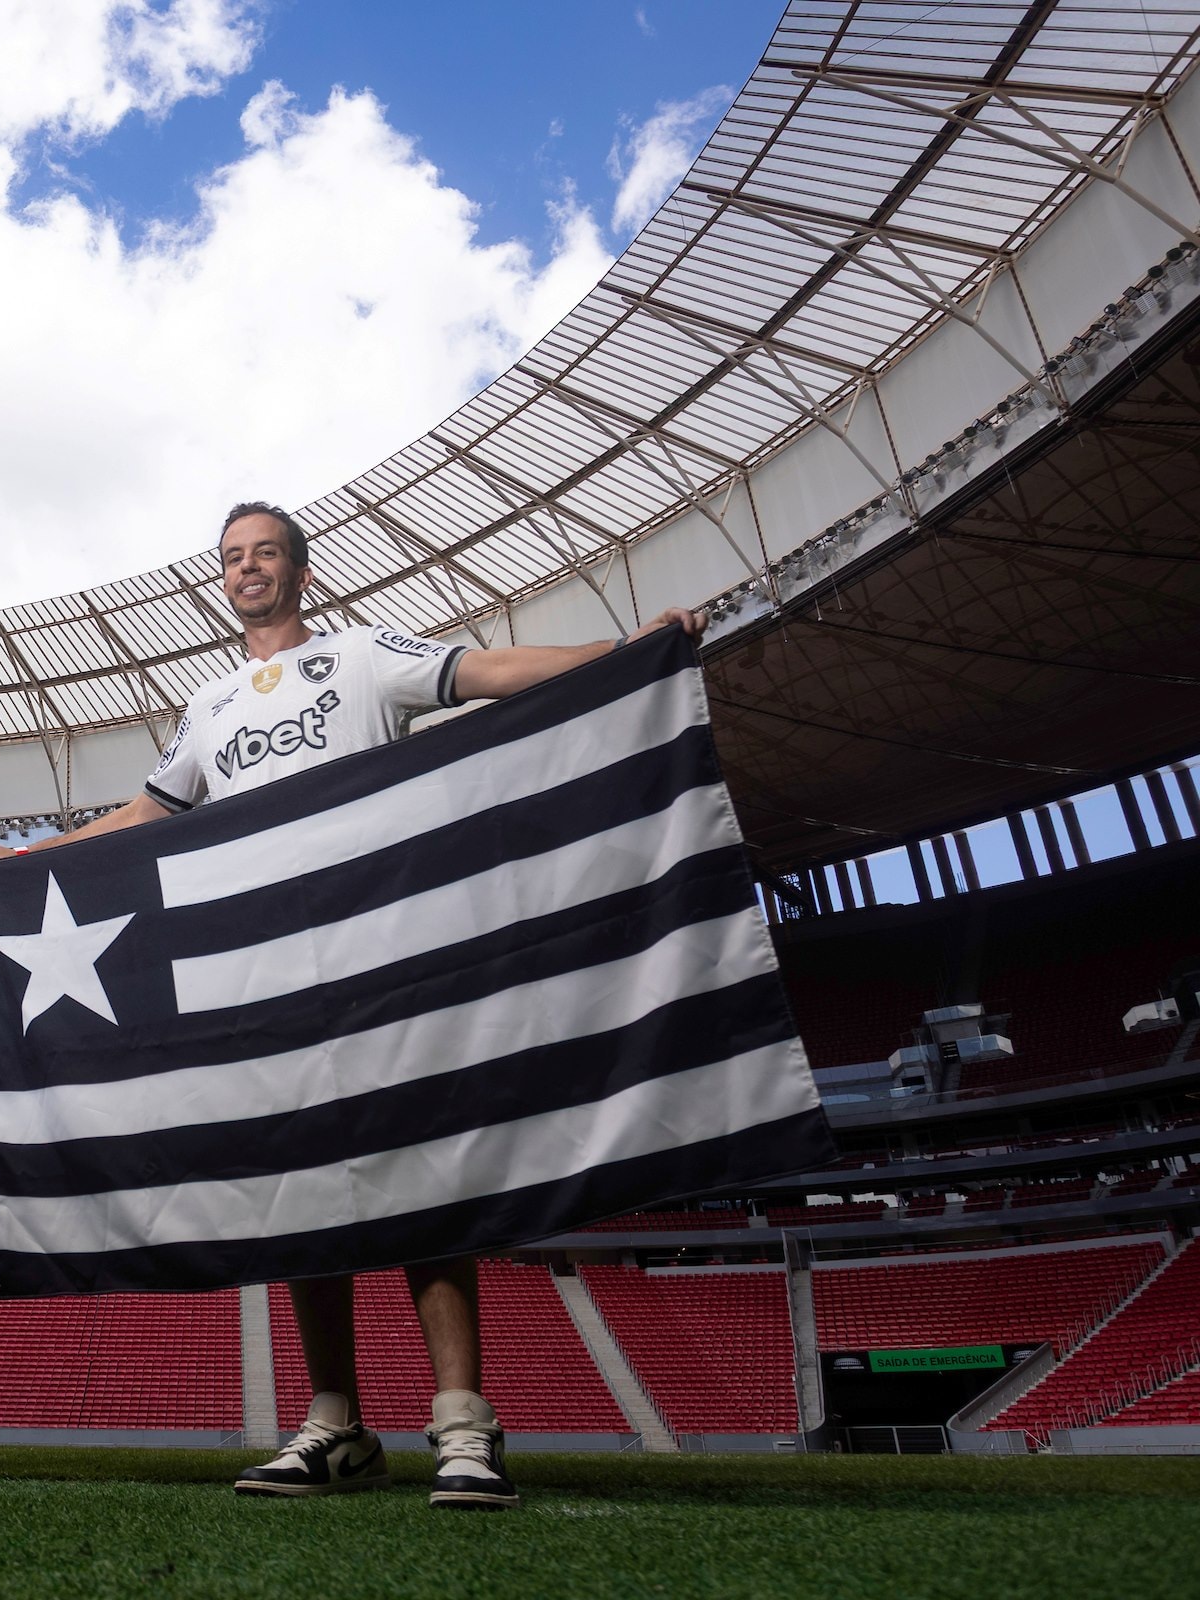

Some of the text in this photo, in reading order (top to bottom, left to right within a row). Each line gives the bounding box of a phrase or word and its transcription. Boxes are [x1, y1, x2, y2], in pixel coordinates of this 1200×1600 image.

[877, 1353, 998, 1367] SAÍDA DE EMERGÊNCIA
